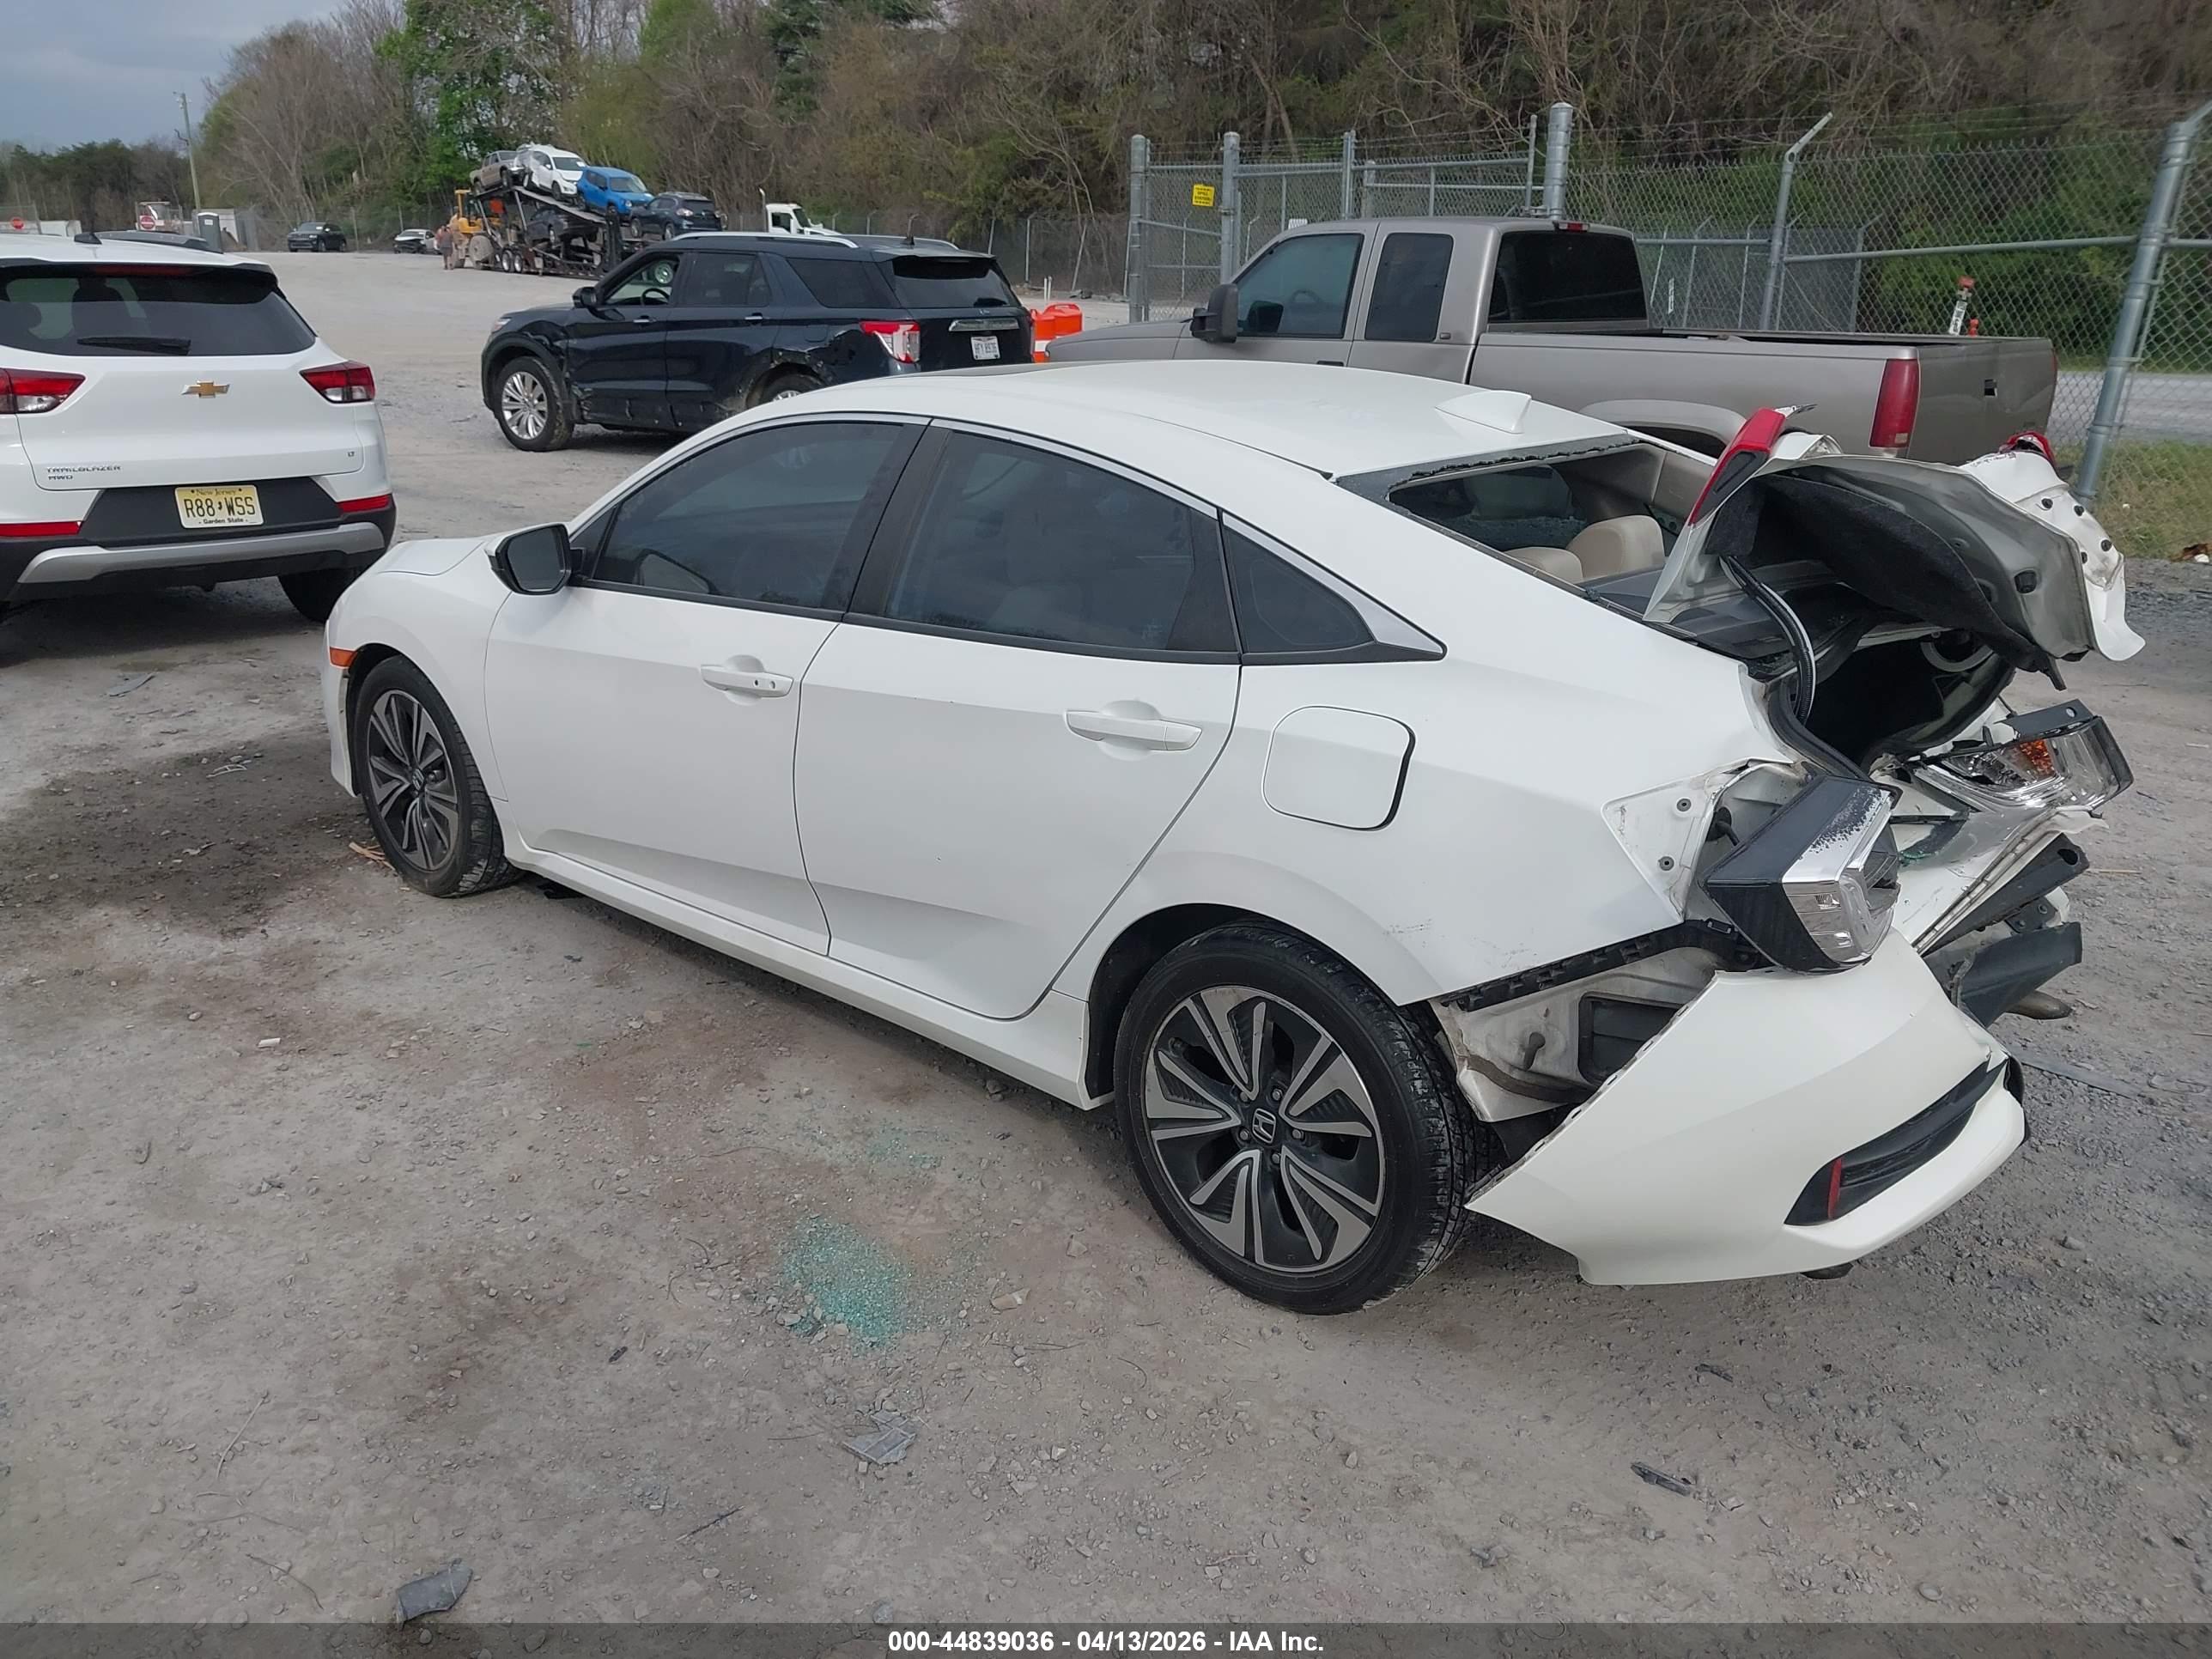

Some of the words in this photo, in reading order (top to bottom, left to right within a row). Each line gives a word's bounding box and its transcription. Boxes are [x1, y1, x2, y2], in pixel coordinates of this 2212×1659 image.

[215, 488, 236, 496] Jersey
[183, 498, 216, 518] R88
[224, 496, 256, 516] WSS
